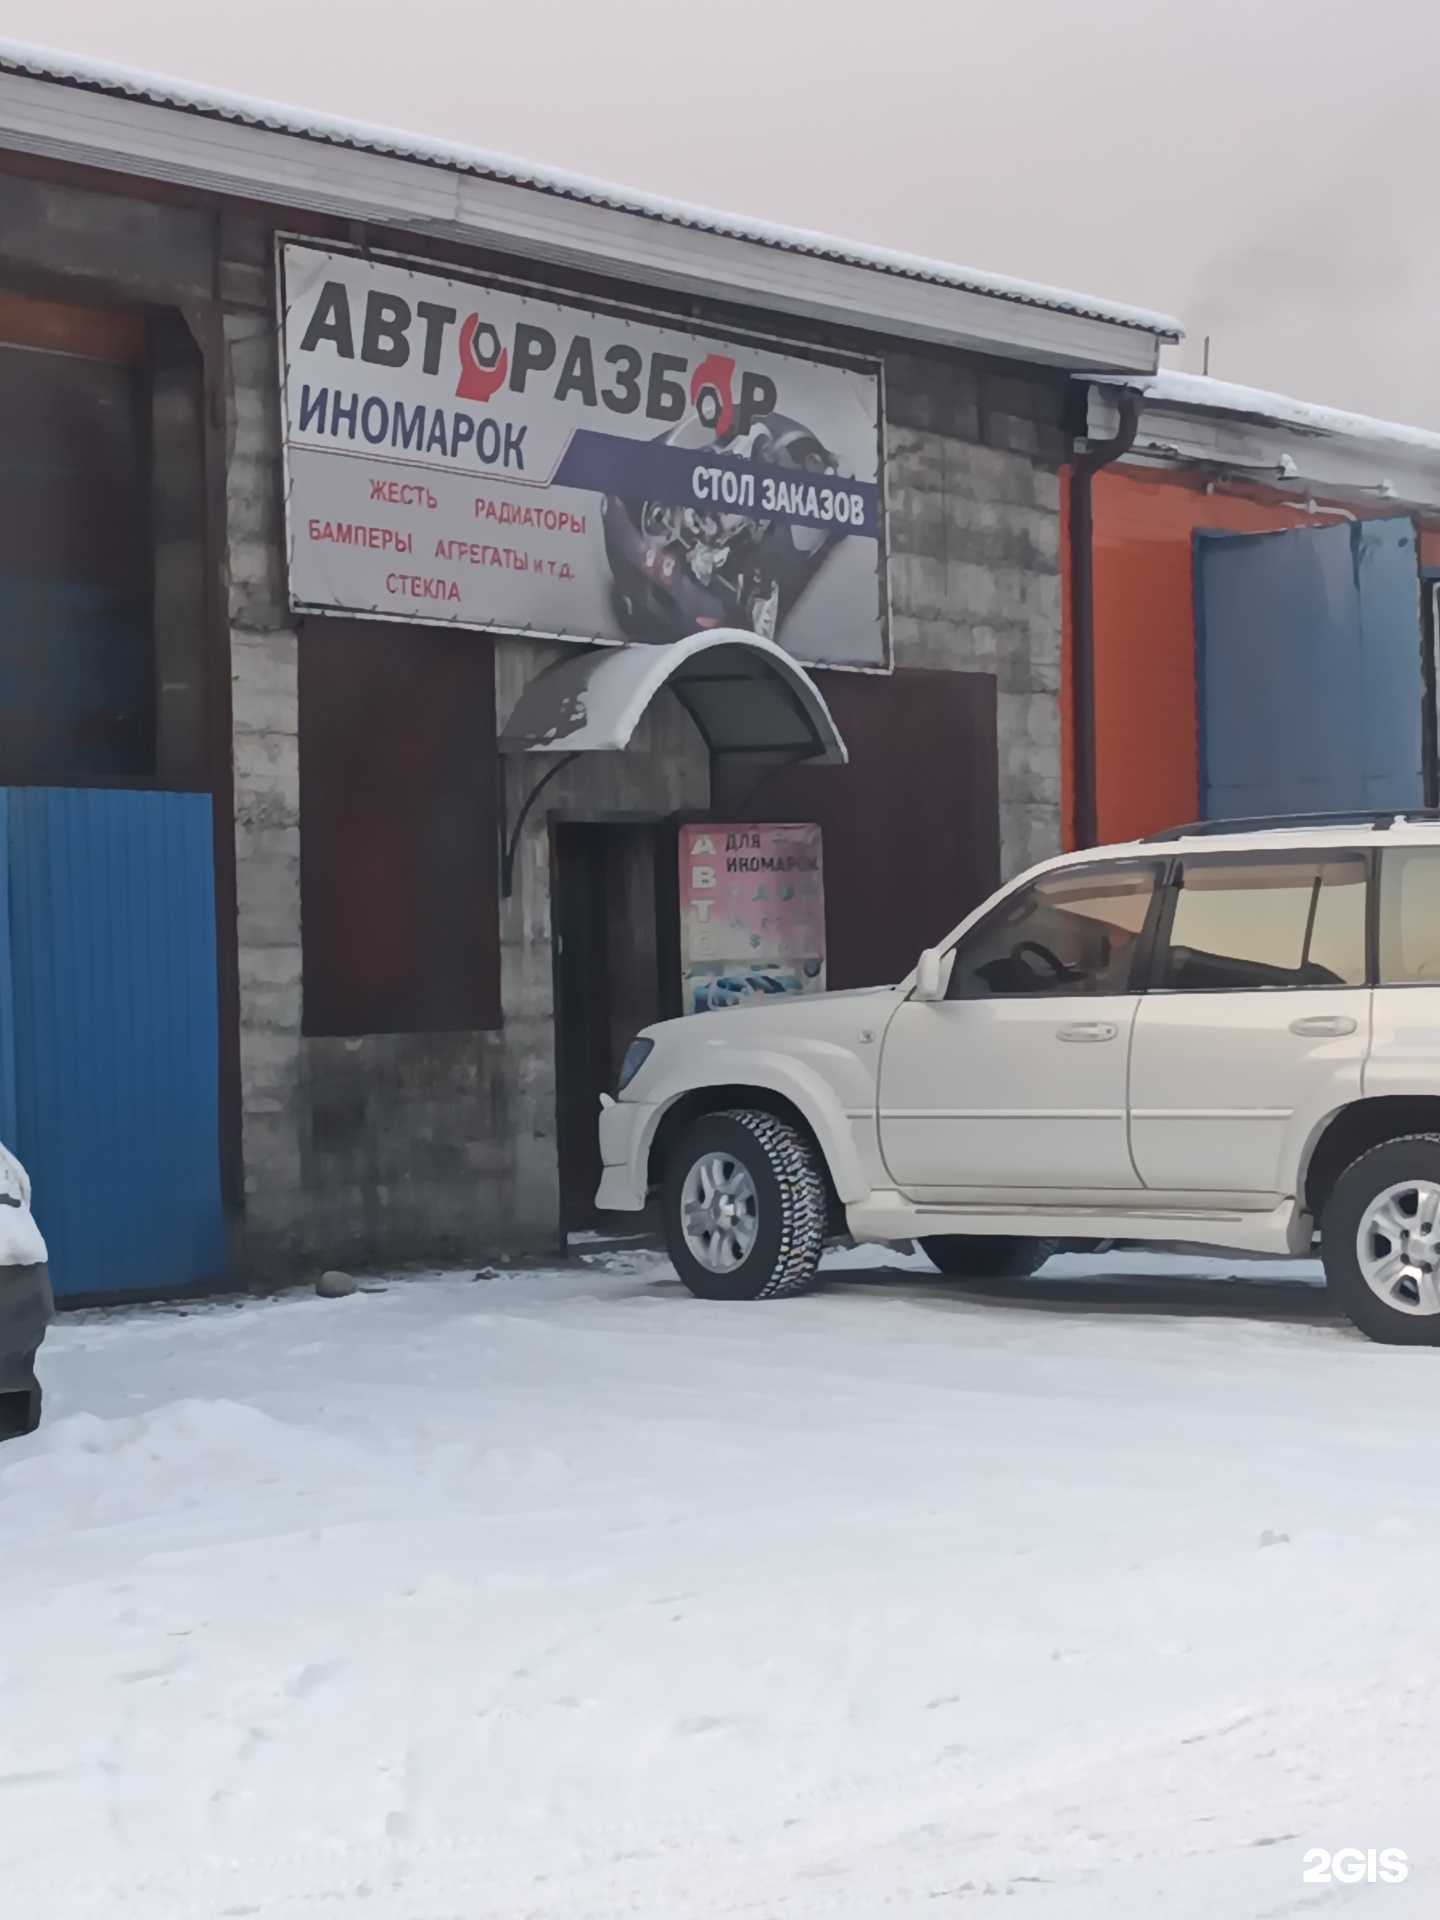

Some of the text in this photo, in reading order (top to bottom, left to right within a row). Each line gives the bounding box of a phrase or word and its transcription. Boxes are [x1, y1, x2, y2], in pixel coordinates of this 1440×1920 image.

[300, 281, 777, 437] АВТОРАЗБОР
[299, 384, 528, 470] ИНОМАРОК
[369, 480, 586, 534] ЖЕСТЬ РАДИАТОРЫ
[692, 466, 865, 526] СТОЛ ЗАКАЗОВ
[308, 519, 412, 553] БАМПЕРЫ
[434, 540, 529, 571] АГРЕГАТЫ
[386, 573, 461, 601] СТЕКЛА
[726, 833, 761, 851] ДЛЯ
